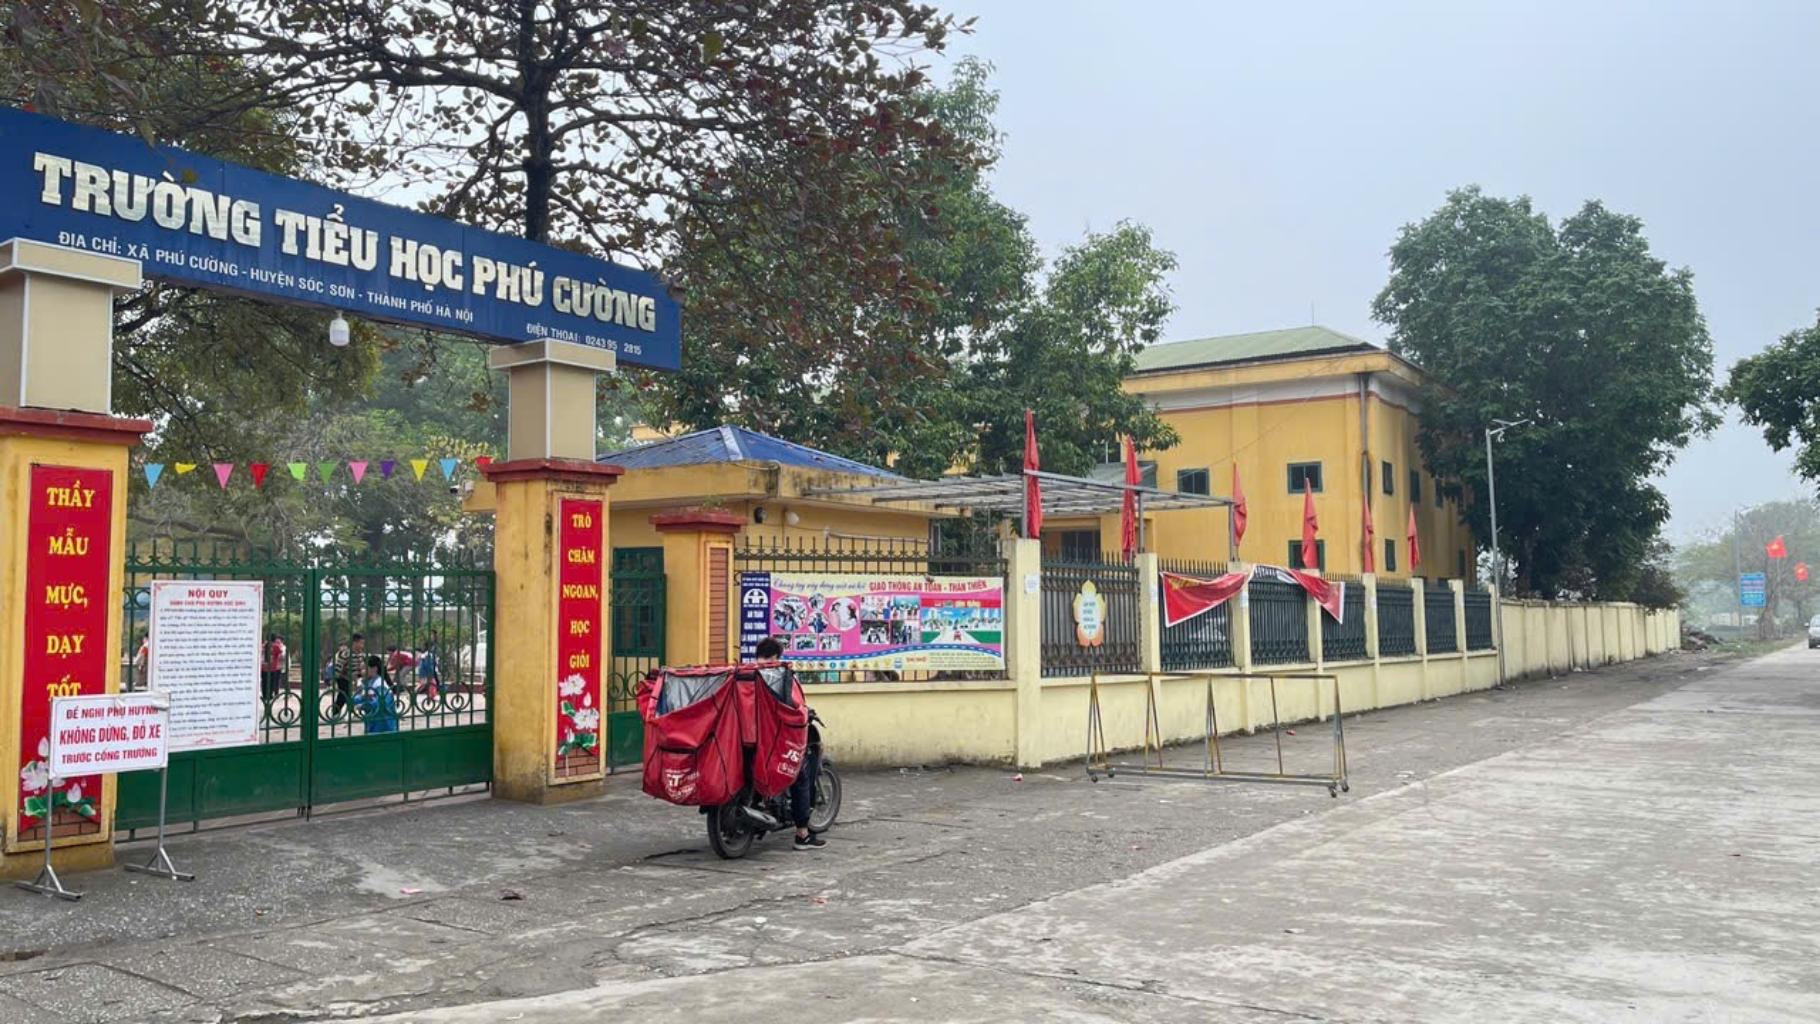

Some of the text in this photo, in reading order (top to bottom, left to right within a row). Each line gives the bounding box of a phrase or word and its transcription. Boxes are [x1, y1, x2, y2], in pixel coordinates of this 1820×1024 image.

[33, 151, 657, 333] TRƯỜNG TIỂU HỌC PHÚ CƯỜNG
[127, 242, 149, 260] XÃ
[155, 249, 185, 266] PHÚ
[189, 255, 239, 277] CƯỜNG
[250, 268, 294, 289] HUYỆN
[298, 276, 324, 293] SÓC
[329, 283, 355, 299] SƠN
[367, 292, 407, 310] THÀNH
[410, 299, 433, 315] PHỐ
[435, 304, 451, 319] HÀ
[455, 310, 473, 325] NỘI
[526, 322, 549, 339] ĐIỆN
[46, 480, 95, 508] THẦY
[49, 528, 89, 555] MẪU
[567, 545, 595, 563] CHĂM
[45, 585, 88, 607] MỰC,
[188, 588, 229, 599] NỘI QUY
[562, 584, 598, 601] NGOAN,
[869, 581, 886, 592] GIAO
[888, 581, 912, 592] THÔNG
[913, 582, 923, 591] AN
[570, 620, 590, 638] HỌC
[46, 635, 85, 659] DẠY
[47, 674, 82, 702] TỐT
[81, 707, 104, 720] NGHỊ
[107, 706, 126, 719] PHỤ
[59, 725, 96, 745] KHÔNG
[148, 724, 161, 739] XE
